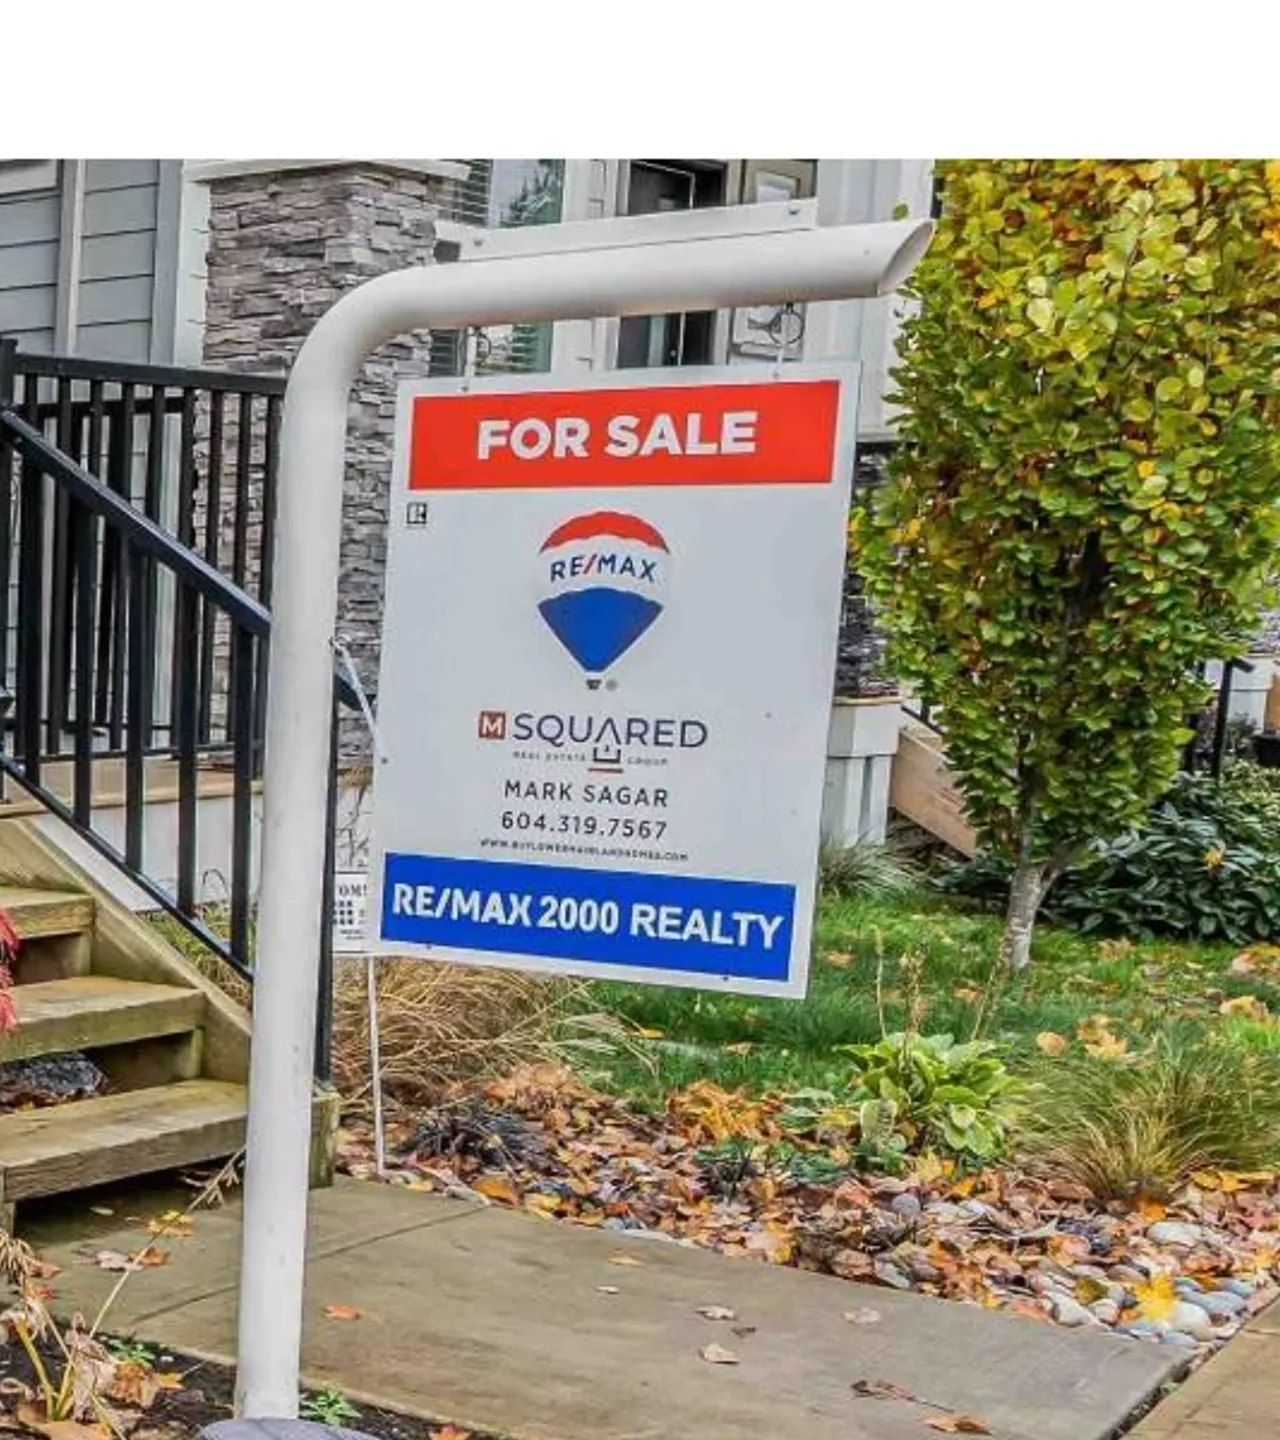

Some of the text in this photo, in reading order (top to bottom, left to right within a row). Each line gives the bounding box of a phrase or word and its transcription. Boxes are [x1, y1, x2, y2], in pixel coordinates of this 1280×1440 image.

[476, 411, 758, 460] FOR SALE
[550, 553, 658, 583] RE/MAX
[512, 712, 708, 749] SQUARED
[504, 779, 669, 808] MARK SAGAR
[501, 811, 667, 840] 604.319.7567
[392, 882, 784, 950] RE/MAX 2000 REALTY
